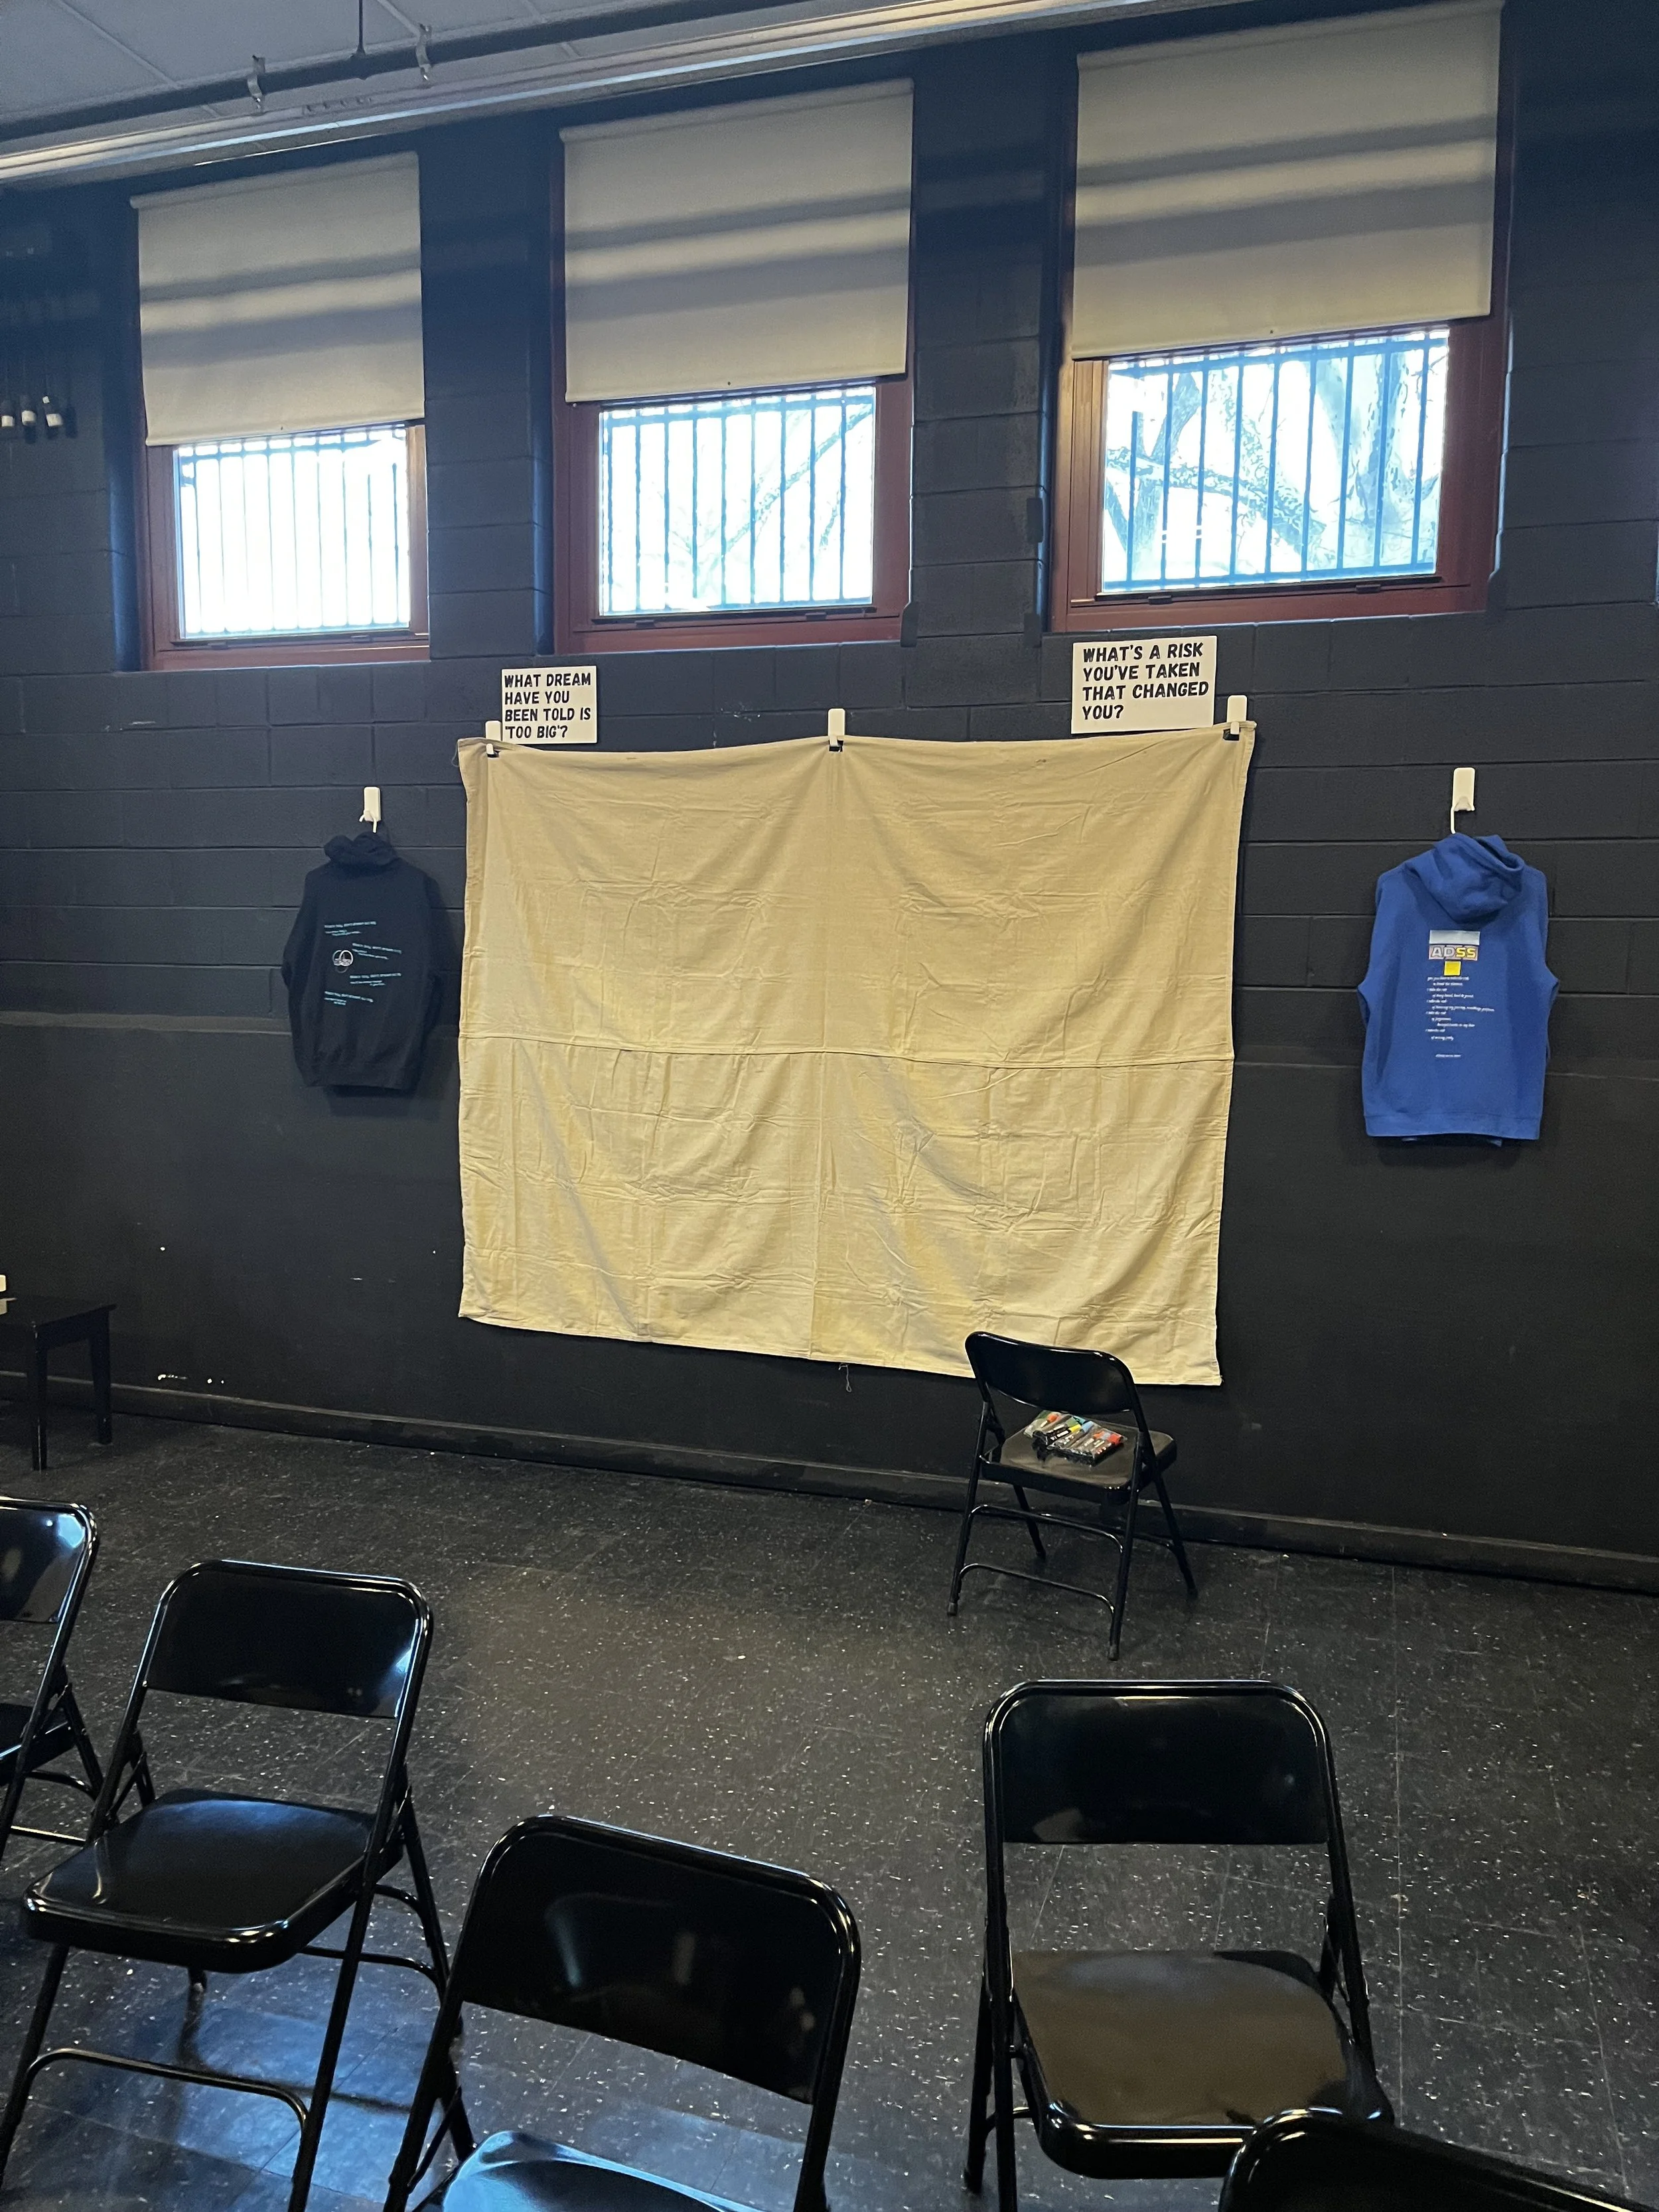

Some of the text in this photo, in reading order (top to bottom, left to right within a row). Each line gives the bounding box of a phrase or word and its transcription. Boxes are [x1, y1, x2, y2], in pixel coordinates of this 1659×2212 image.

[1083, 642, 1204, 662] WHAT'S A RISK
[504, 672, 591, 688] WHAT DREAM
[1083, 662, 1200, 682] YOU'VE TAKEN
[504, 690, 570, 705] HAVE YOU
[1082, 681, 1209, 701] THAT CHANGED
[505, 707, 591, 722] BEEN TOLD IS
[1082, 704, 1124, 720] YOU?
